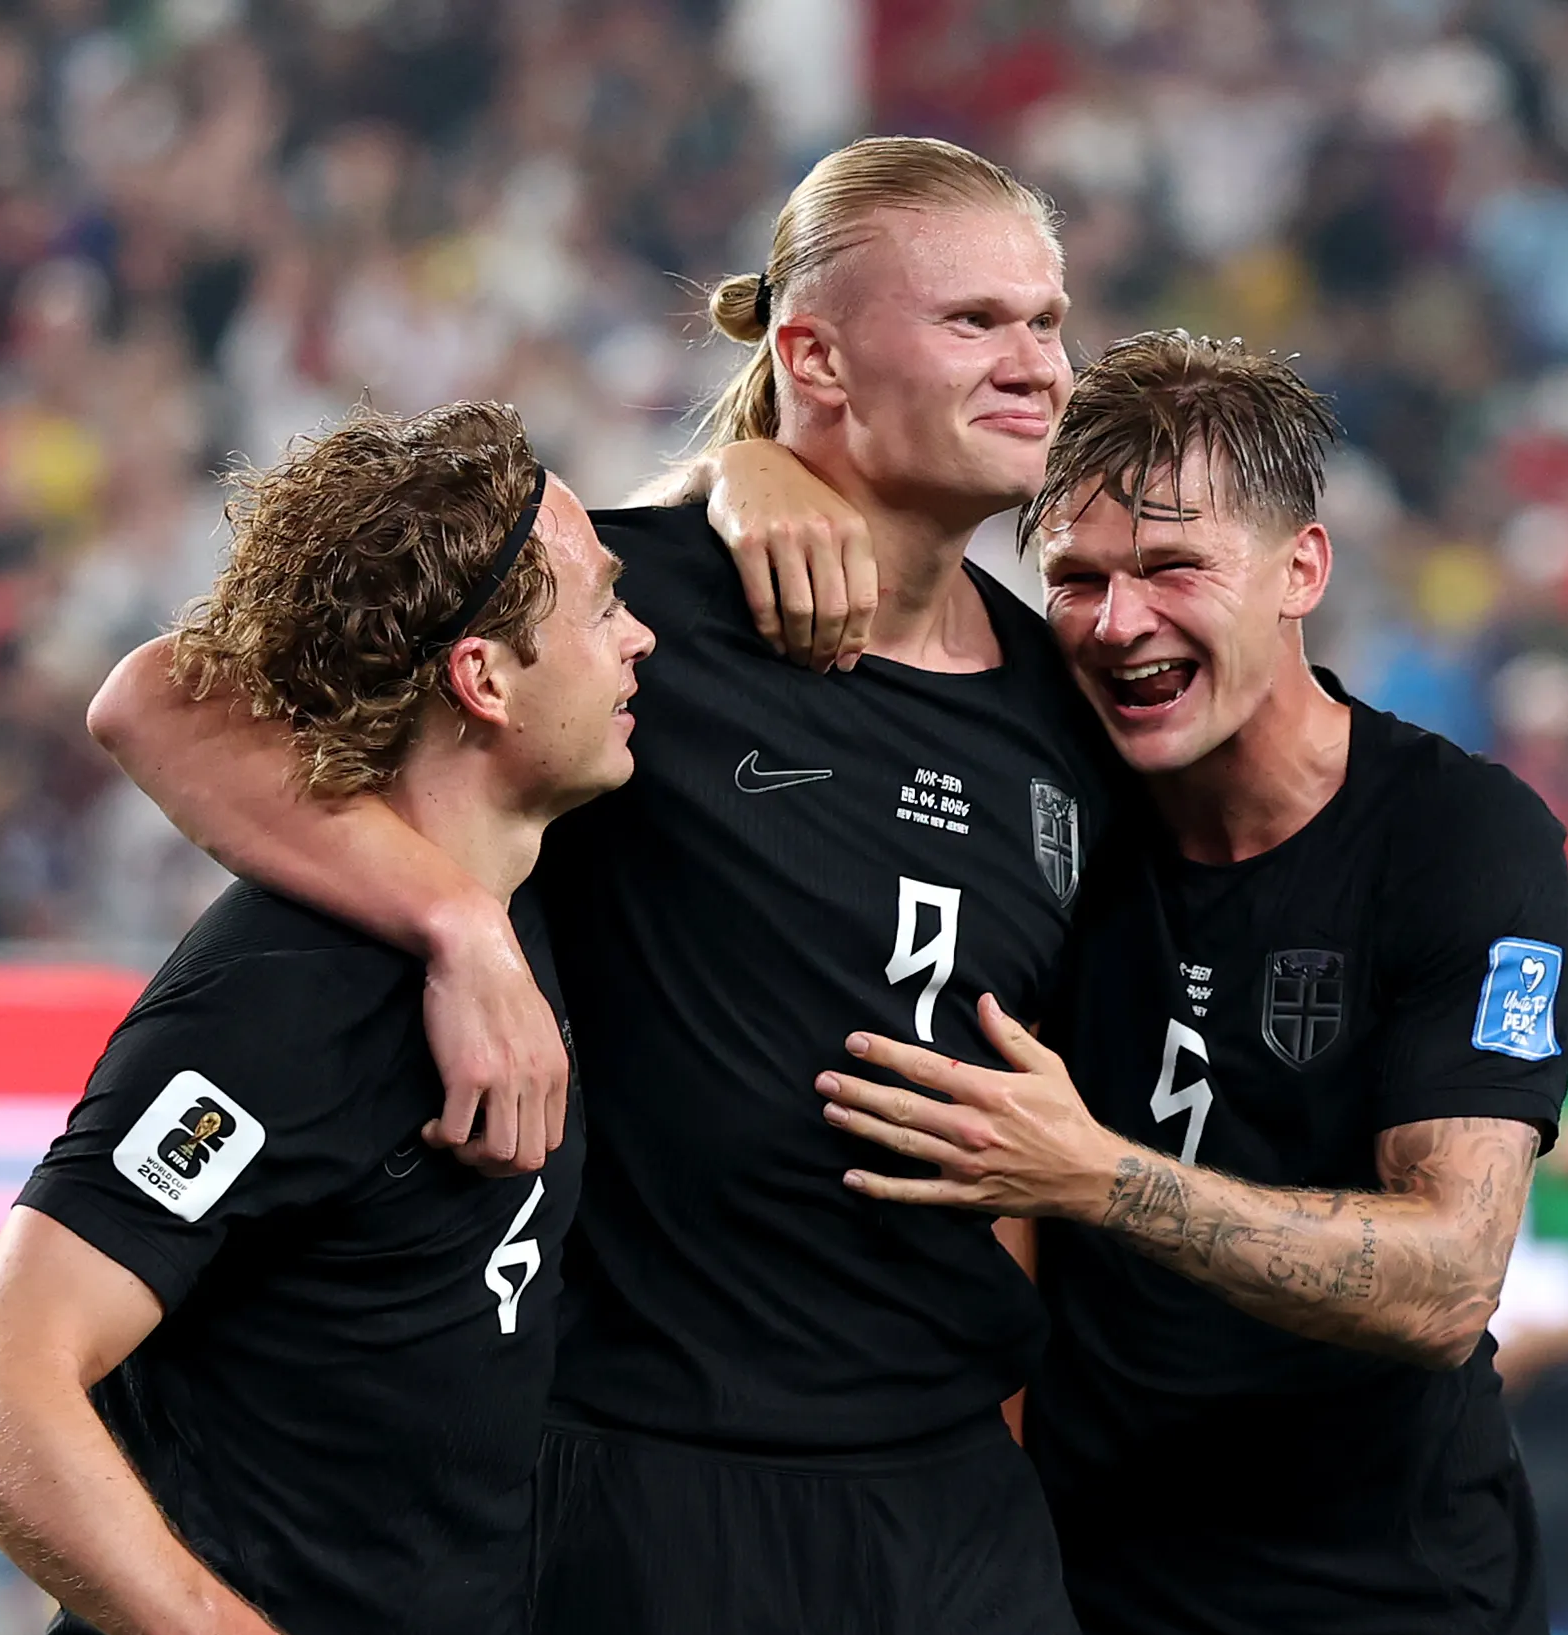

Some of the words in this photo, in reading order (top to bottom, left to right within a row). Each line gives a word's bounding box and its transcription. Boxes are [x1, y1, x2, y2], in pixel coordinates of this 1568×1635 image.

[914, 767, 962, 793] NOR-SEN
[884, 875, 961, 1043] 9
[1150, 1018, 1213, 1166] 5
[146, 1156, 173, 1180] WORLD
[171, 1178, 188, 1192] CUP
[167, 1150, 189, 1171] FIFA
[137, 1164, 181, 1201] 2026
[484, 1175, 545, 1334] 6
